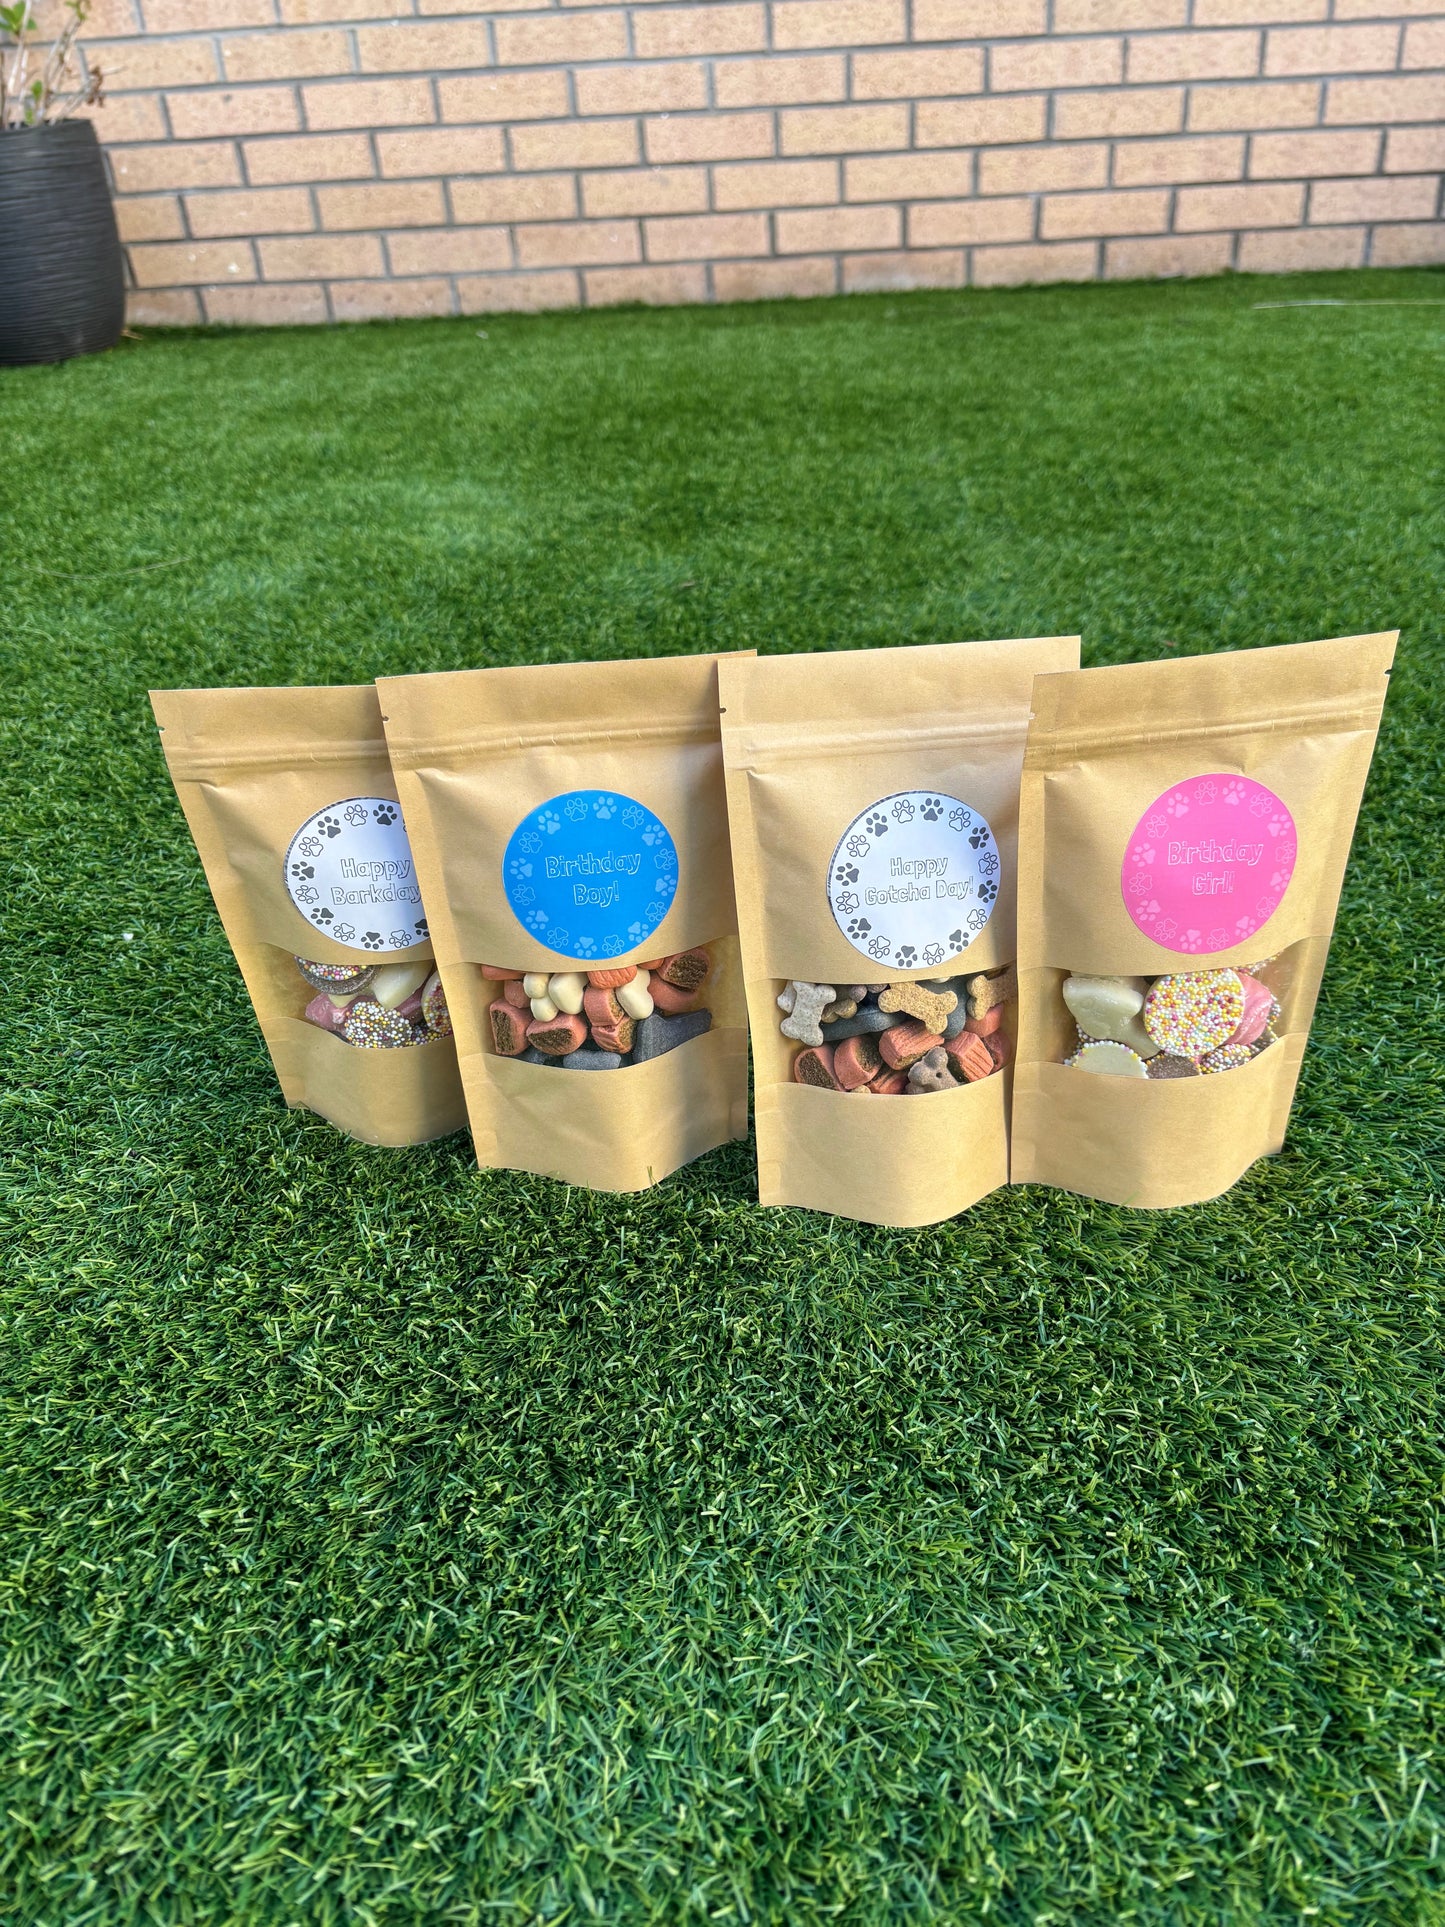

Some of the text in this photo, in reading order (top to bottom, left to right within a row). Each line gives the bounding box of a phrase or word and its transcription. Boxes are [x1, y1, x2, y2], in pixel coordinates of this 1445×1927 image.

[545, 851, 641, 878] Birthday
[1167, 839, 1264, 866] Birthday
[340, 858, 410, 881] Happy
[890, 857, 948, 879] Happy
[573, 880, 620, 908] Boy!
[865, 876, 974, 905] Gotcha Day!
[1192, 871, 1235, 895] Girl!
